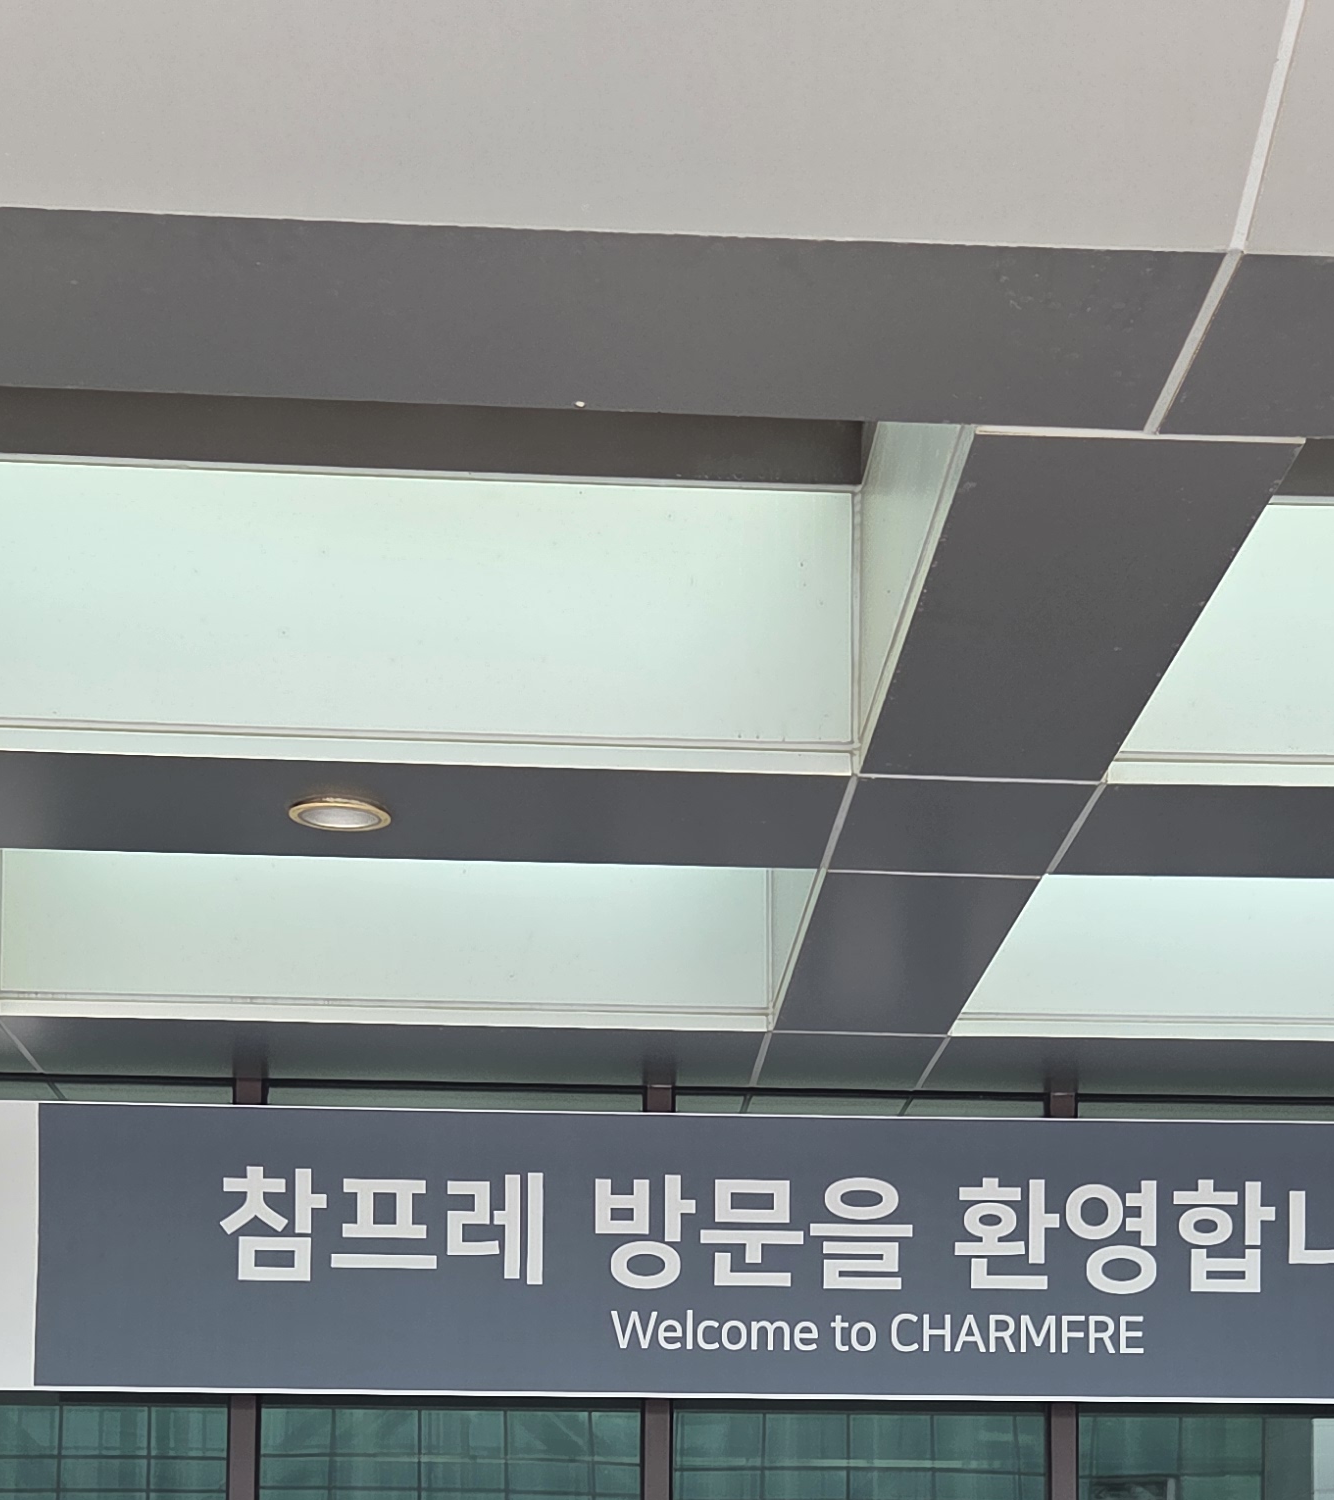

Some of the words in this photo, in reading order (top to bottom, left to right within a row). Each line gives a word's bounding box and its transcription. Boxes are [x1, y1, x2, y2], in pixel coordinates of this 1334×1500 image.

[219, 1165, 544, 1286] 참프레
[594, 1174, 914, 1291] 방문을
[610, 1309, 819, 1352] Welcome
[830, 1313, 877, 1353] to
[890, 1312, 1145, 1355] CHARMFRE
